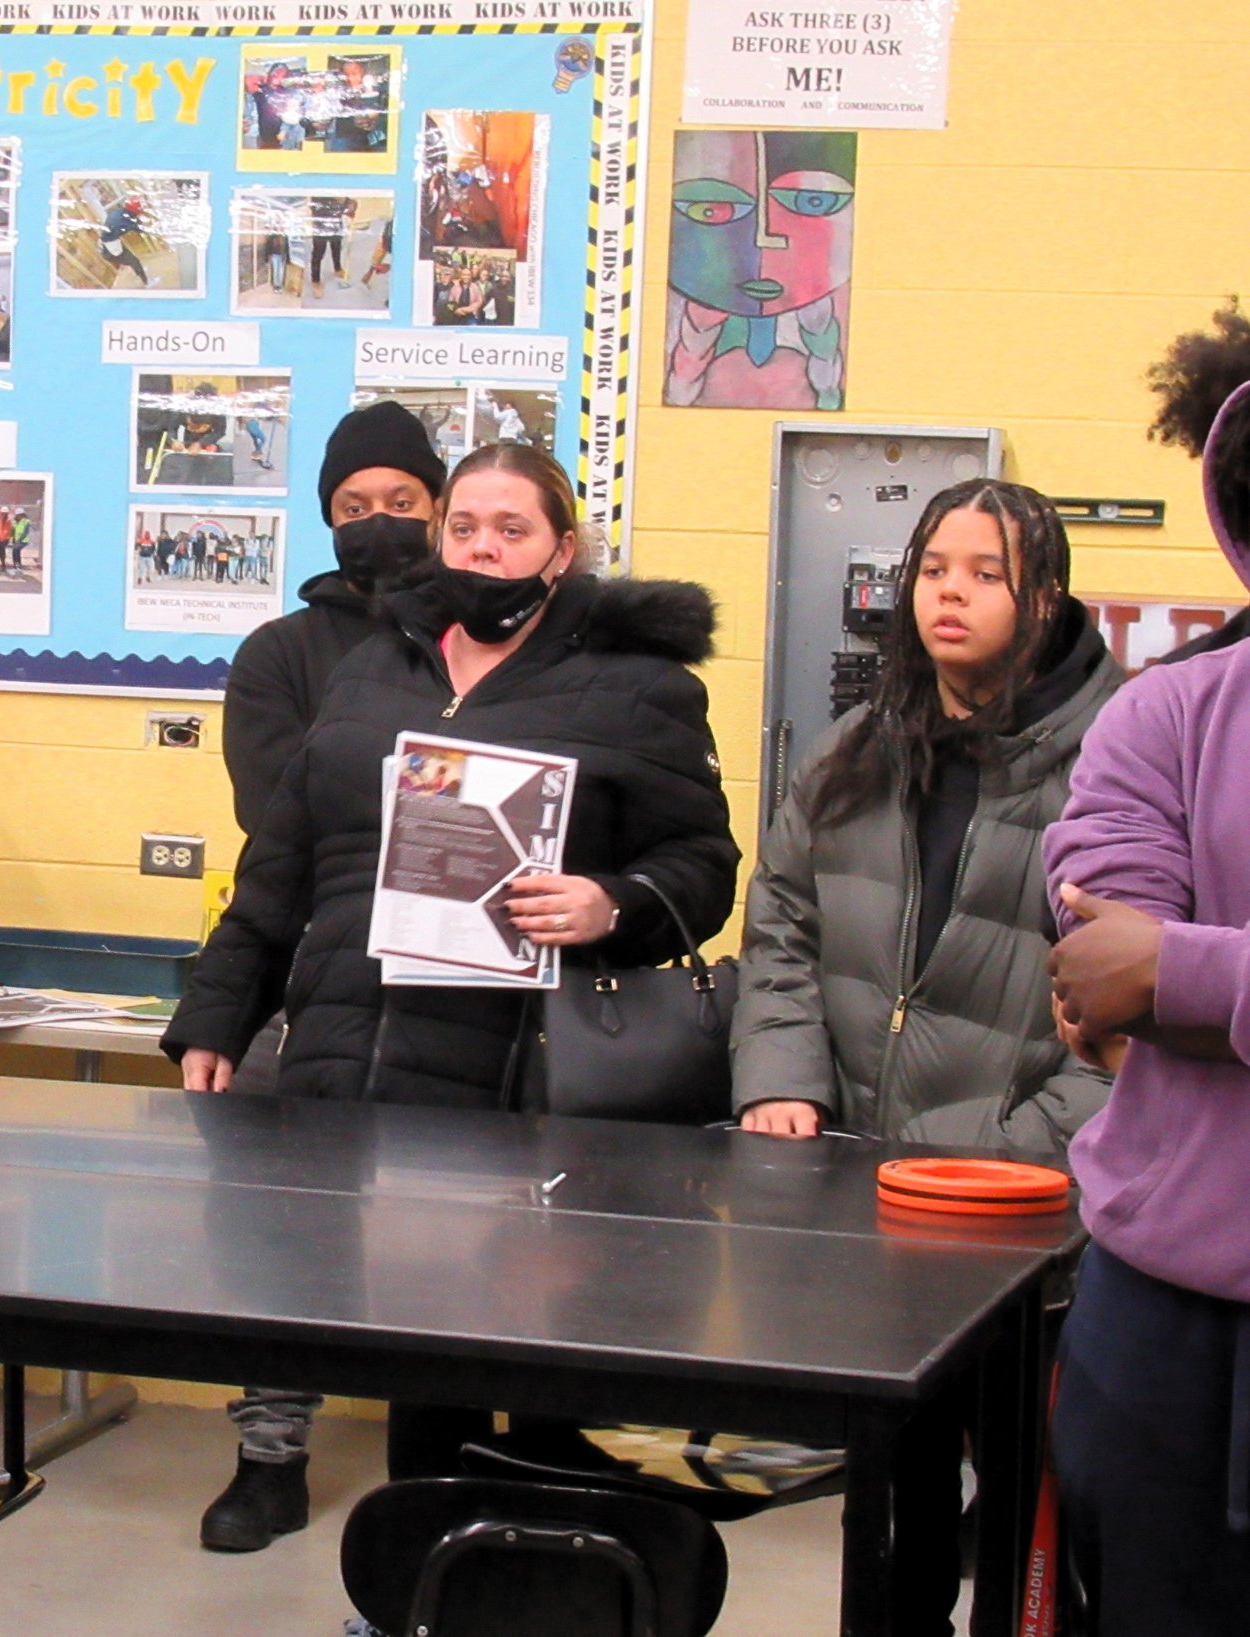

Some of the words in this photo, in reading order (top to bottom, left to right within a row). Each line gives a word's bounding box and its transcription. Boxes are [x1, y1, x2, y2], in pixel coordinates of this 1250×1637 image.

[52, 4, 98, 20] KIDS
[106, 4, 134, 20] AT
[141, 4, 201, 21] WORK
[215, 3, 277, 20] WORK
[298, 3, 349, 20] KIDS
[355, 3, 383, 19] AT
[391, 3, 454, 19] WORK
[475, 2, 526, 18] KIDS
[533, 2, 562, 18] AT
[569, 1, 634, 18] WORK
[744, 11, 785, 28] ASK
[792, 12, 857, 31] THREE
[862, 13, 892, 35] (3)
[731, 36, 811, 54] BEFORE
[816, 37, 857, 55] YOU
[862, 39, 903, 57] ASK
[610, 43, 627, 100] KIDS
[785, 66, 844, 92] ME!
[702, 97, 786, 109] COLLABORATION
[801, 101, 823, 110] AND
[837, 102, 925, 113] COMMUNICATION
[608, 105, 624, 134] AT
[605, 140, 622, 206] WORK
[602, 229, 619, 283] KIDS
[600, 289, 616, 317] AT
[107, 329, 226, 353] Hands-On
[360, 340, 448, 366] Service
[458, 343, 565, 374] Learning
[597, 323, 615, 391] WORK
[594, 414, 610, 467] KIDS
[592, 475, 608, 503] AT
[183, 600, 227, 609] TECHNICAL
[228, 601, 269, 610] INSTITUTE
[1028, 1549, 1046, 1619] ACADEMY
